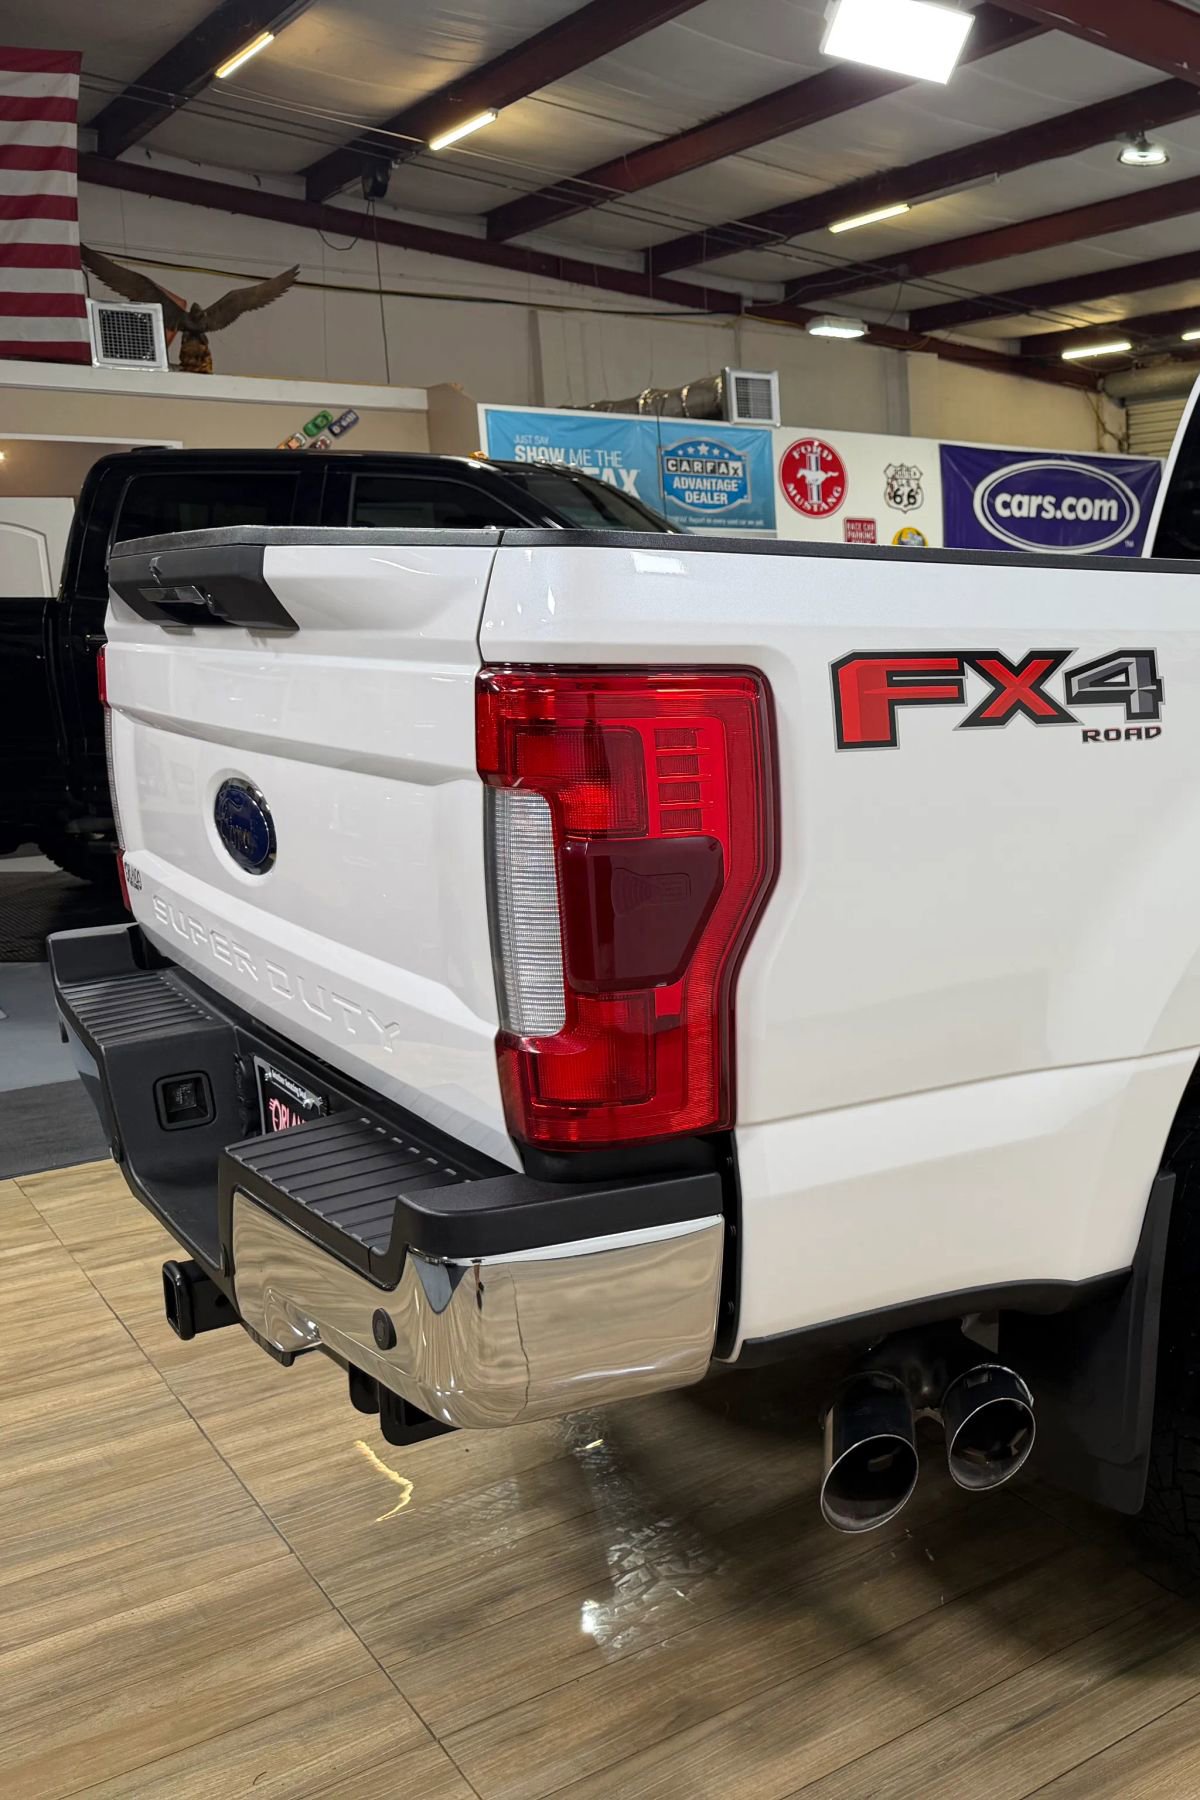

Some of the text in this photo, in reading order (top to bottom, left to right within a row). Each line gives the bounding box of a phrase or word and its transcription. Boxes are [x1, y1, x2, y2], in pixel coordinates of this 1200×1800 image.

[514, 434, 531, 444] JUST
[515, 445, 623, 467] SHOW ME THE
[792, 443, 833, 461] FORD
[666, 458, 743, 477] CARFAX
[673, 476, 739, 492] ADVANTAGE
[685, 490, 728, 504] DEALER
[786, 482, 842, 512] MUSTANG
[893, 488, 917, 506] 66
[995, 493, 1118, 521] cars.com
[828, 647, 1166, 752] FX4
[1082, 726, 1163, 744] ROAD
[153, 895, 401, 1053] SUPER DUTY
